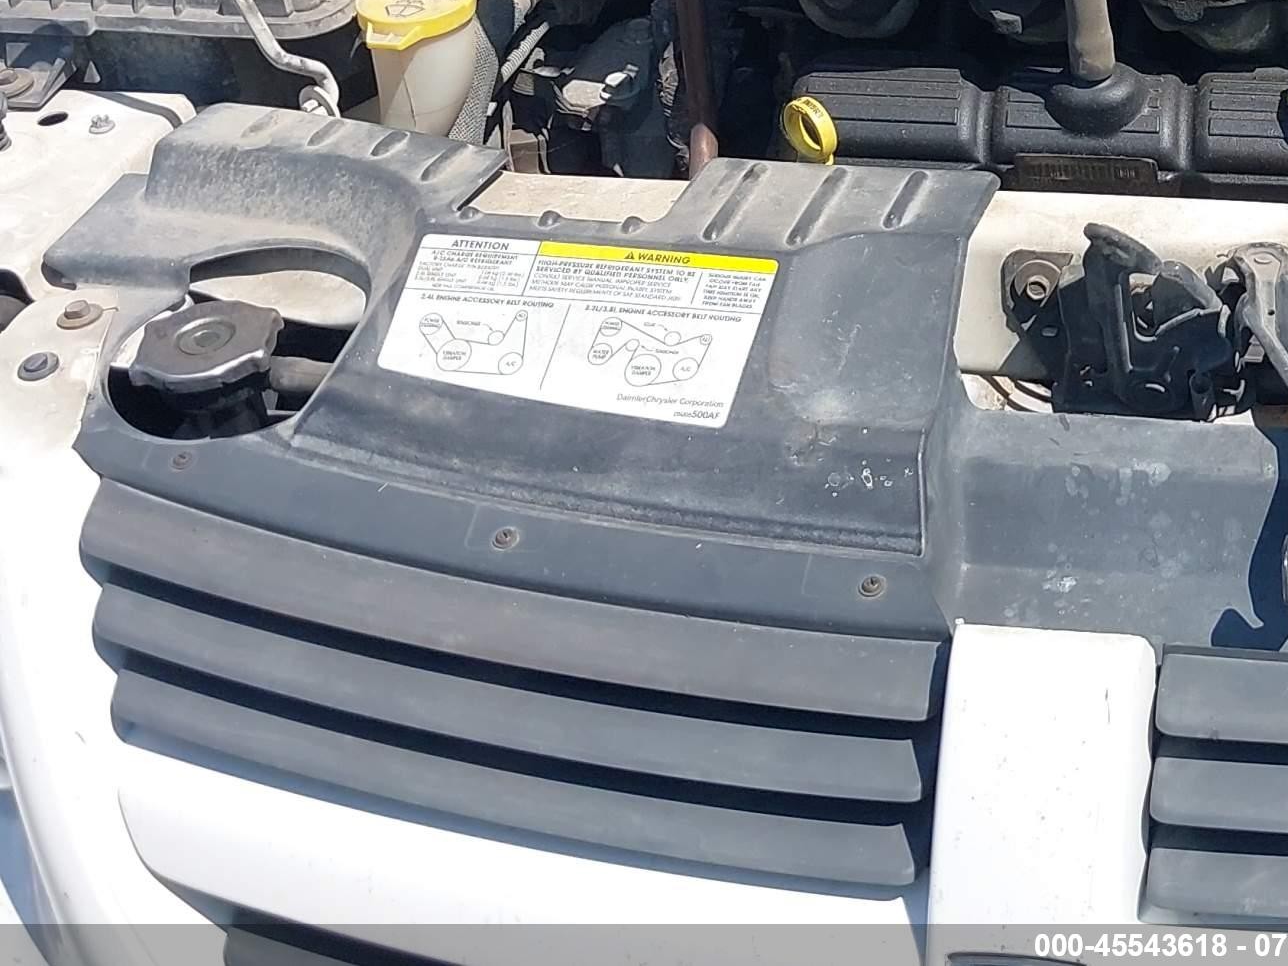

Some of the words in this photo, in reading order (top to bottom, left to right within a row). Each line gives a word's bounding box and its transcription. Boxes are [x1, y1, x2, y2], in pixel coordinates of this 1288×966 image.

[451, 239, 508, 250] ATTENTION
[637, 253, 691, 264] WARNING
[462, 294, 504, 306] ACCESSORY
[522, 299, 554, 308] ROUTING
[646, 308, 690, 319] ACCESSORY
[616, 393, 678, 406] DaimlerChrysler
[680, 398, 724, 408] Corporation
